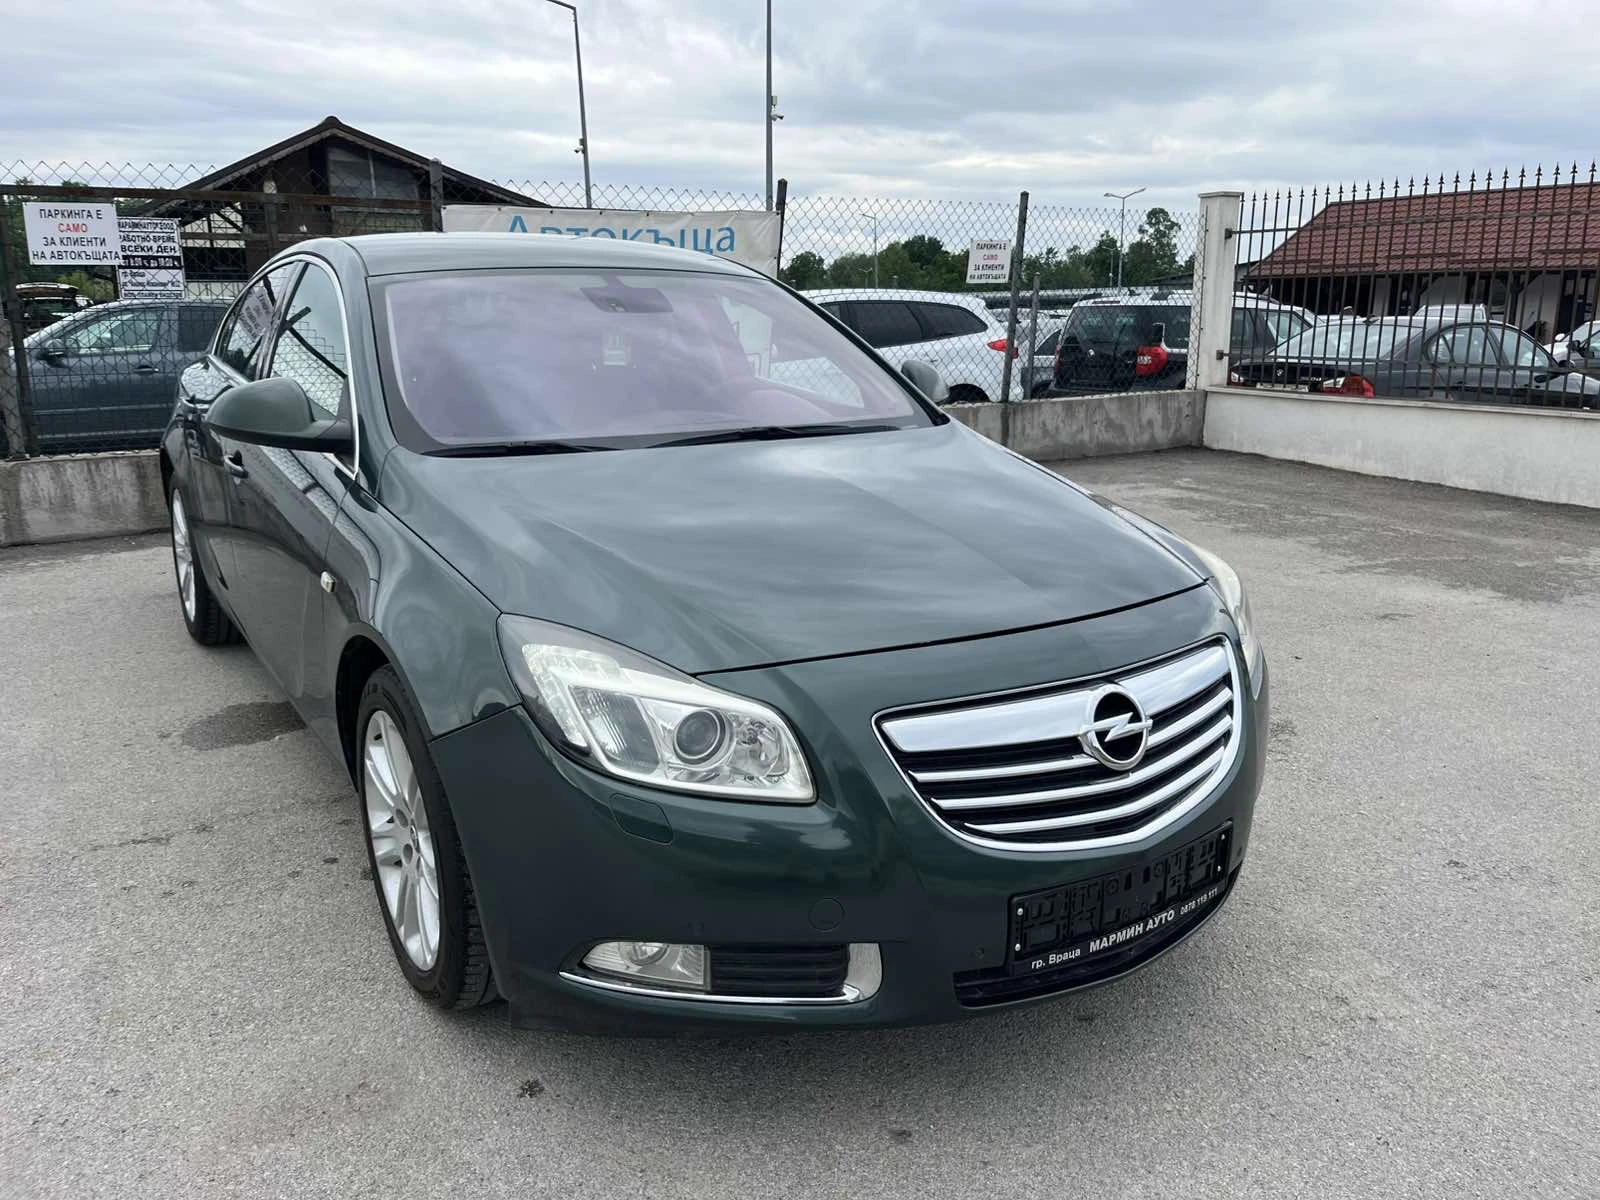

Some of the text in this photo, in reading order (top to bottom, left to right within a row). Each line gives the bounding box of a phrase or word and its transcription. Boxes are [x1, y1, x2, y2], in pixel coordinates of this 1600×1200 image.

[39, 208, 103, 220] ПАРКИНГА Е
[57, 223, 88, 233] САМО
[42, 236, 106, 247] ЗА КЛИЕНТИ
[120, 244, 176, 254] ВСЕКИ ДЕН
[32, 250, 46, 261] НА
[50, 250, 121, 262] АВТОКЪЩАТА
[1031, 959, 1046, 969] гр.
[1048, 948, 1081, 965] Враца
[1089, 922, 1144, 953] МАРМИН
[1145, 909, 1175, 932] АУТО
